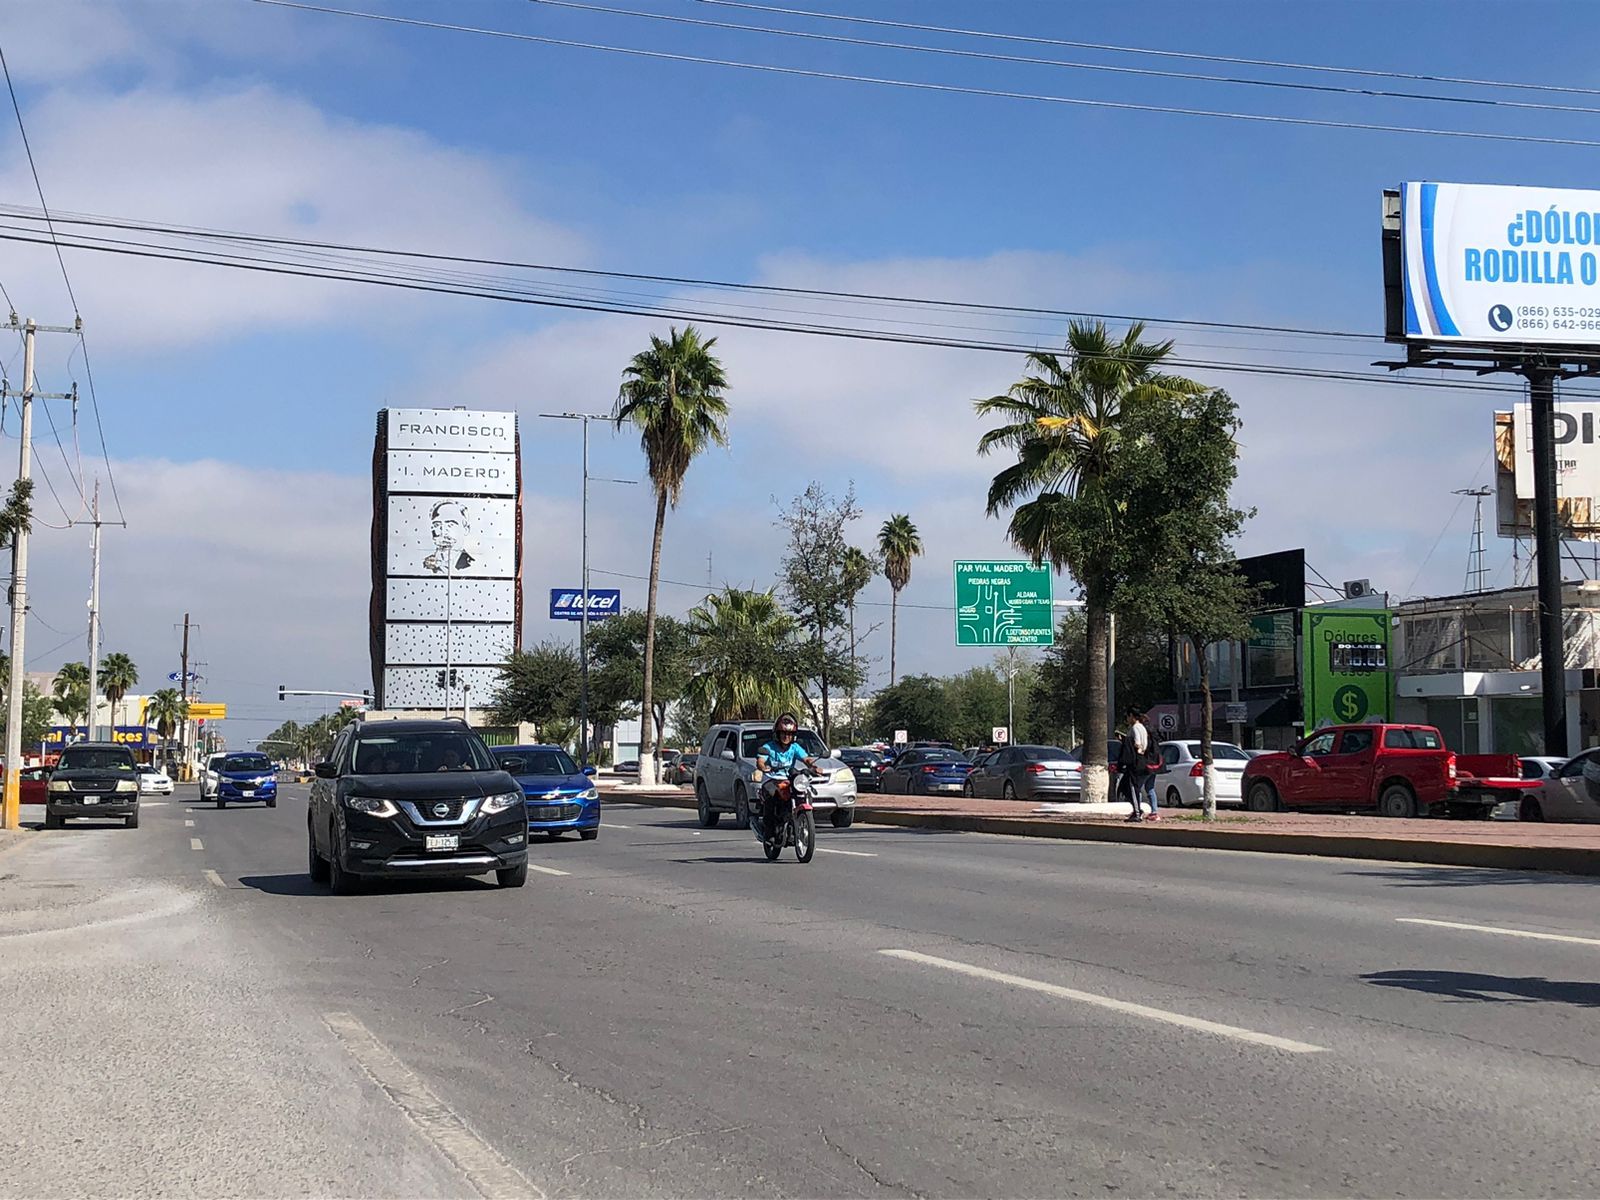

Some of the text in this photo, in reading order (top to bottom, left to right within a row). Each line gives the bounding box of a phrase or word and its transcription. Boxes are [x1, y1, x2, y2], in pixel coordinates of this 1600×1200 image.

[1464, 247, 1597, 286] RODILLA O
[1516, 306, 1549, 318] (866)
[1516, 319, 1549, 330] (866)
[400, 423, 504, 437] FRANCISCO
[1554, 411, 1600, 444] DI
[404, 466, 500, 479] I. MADERO
[957, 564, 973, 573] PAR
[975, 564, 991, 573] VIAL
[993, 564, 1024, 573] MADERO
[1324, 630, 1377, 643] Dólares
